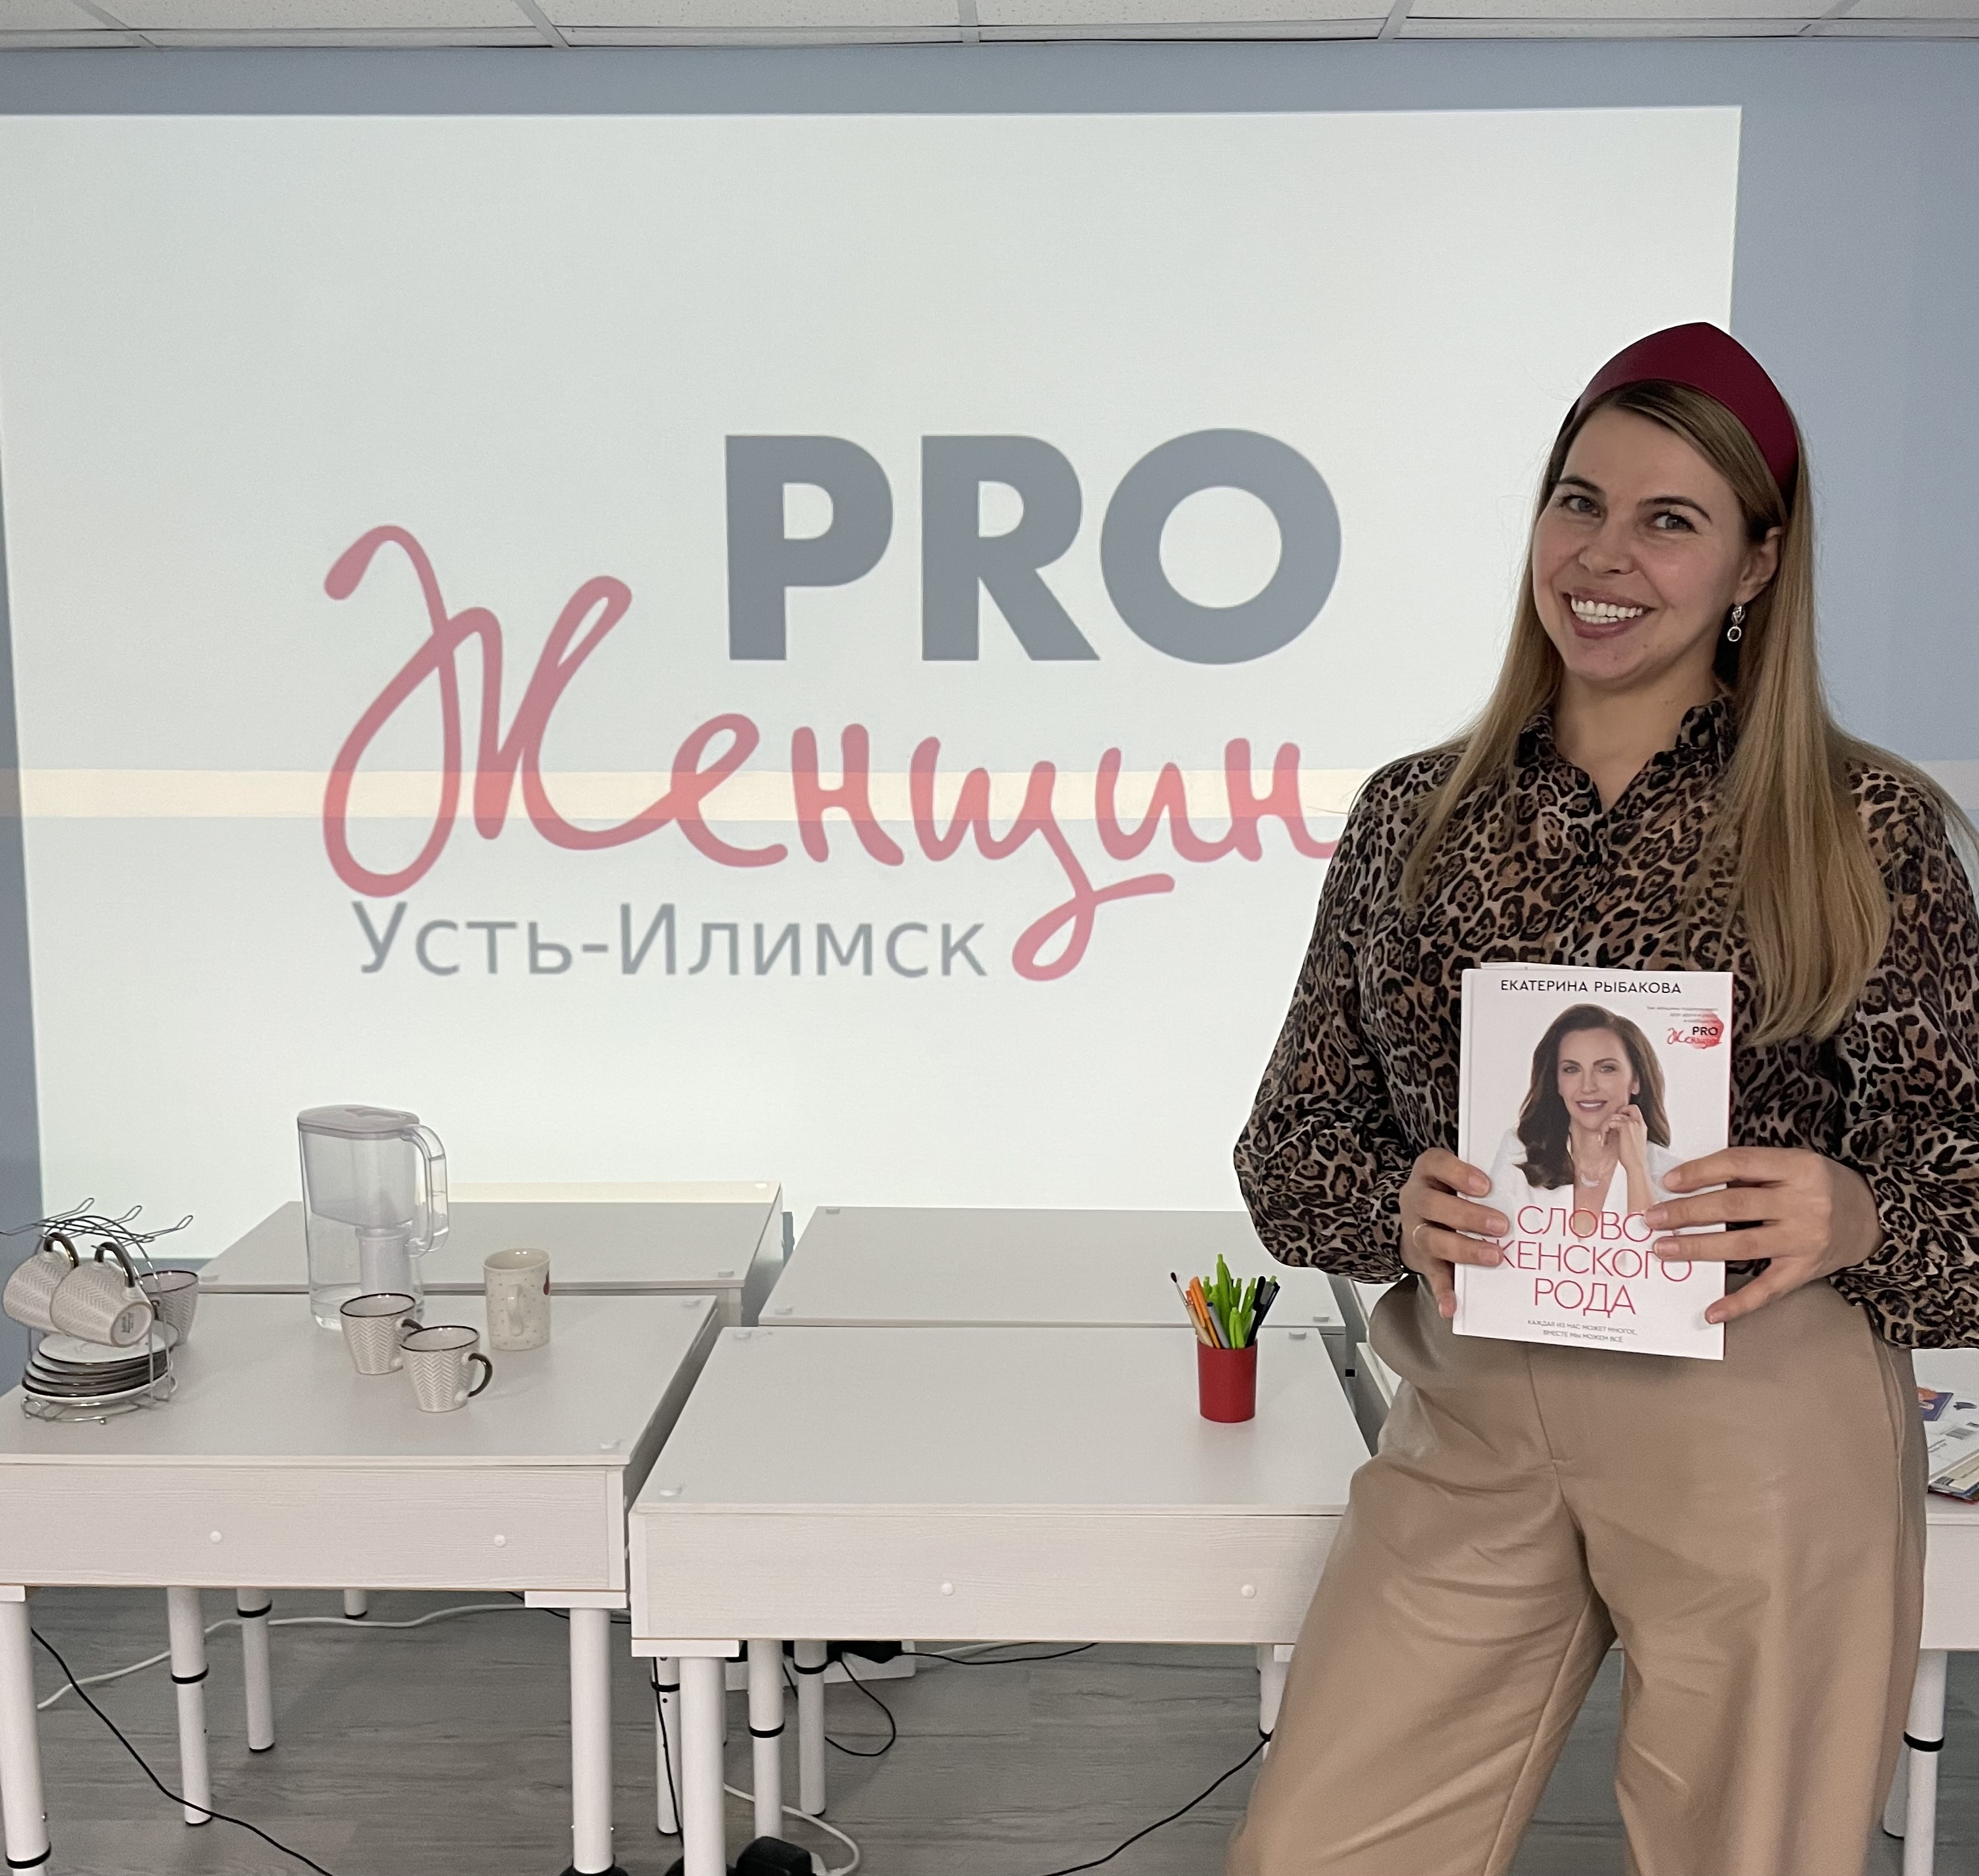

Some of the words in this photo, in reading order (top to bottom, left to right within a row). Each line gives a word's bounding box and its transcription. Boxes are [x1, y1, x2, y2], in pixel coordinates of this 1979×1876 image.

[725, 427, 1342, 665] PRO
[323, 524, 1339, 982] Женщин
[351, 901, 988, 978] Усть-Илимск
[1501, 979, 1588, 992] ЕКАТЕРИНА
[1594, 981, 1681, 994] РЫБАКОВА
[1692, 1026, 1719, 1036] PRO
[1518, 1205, 1654, 1242] СЛОВО
[1535, 1278, 1636, 1318] РОДА
